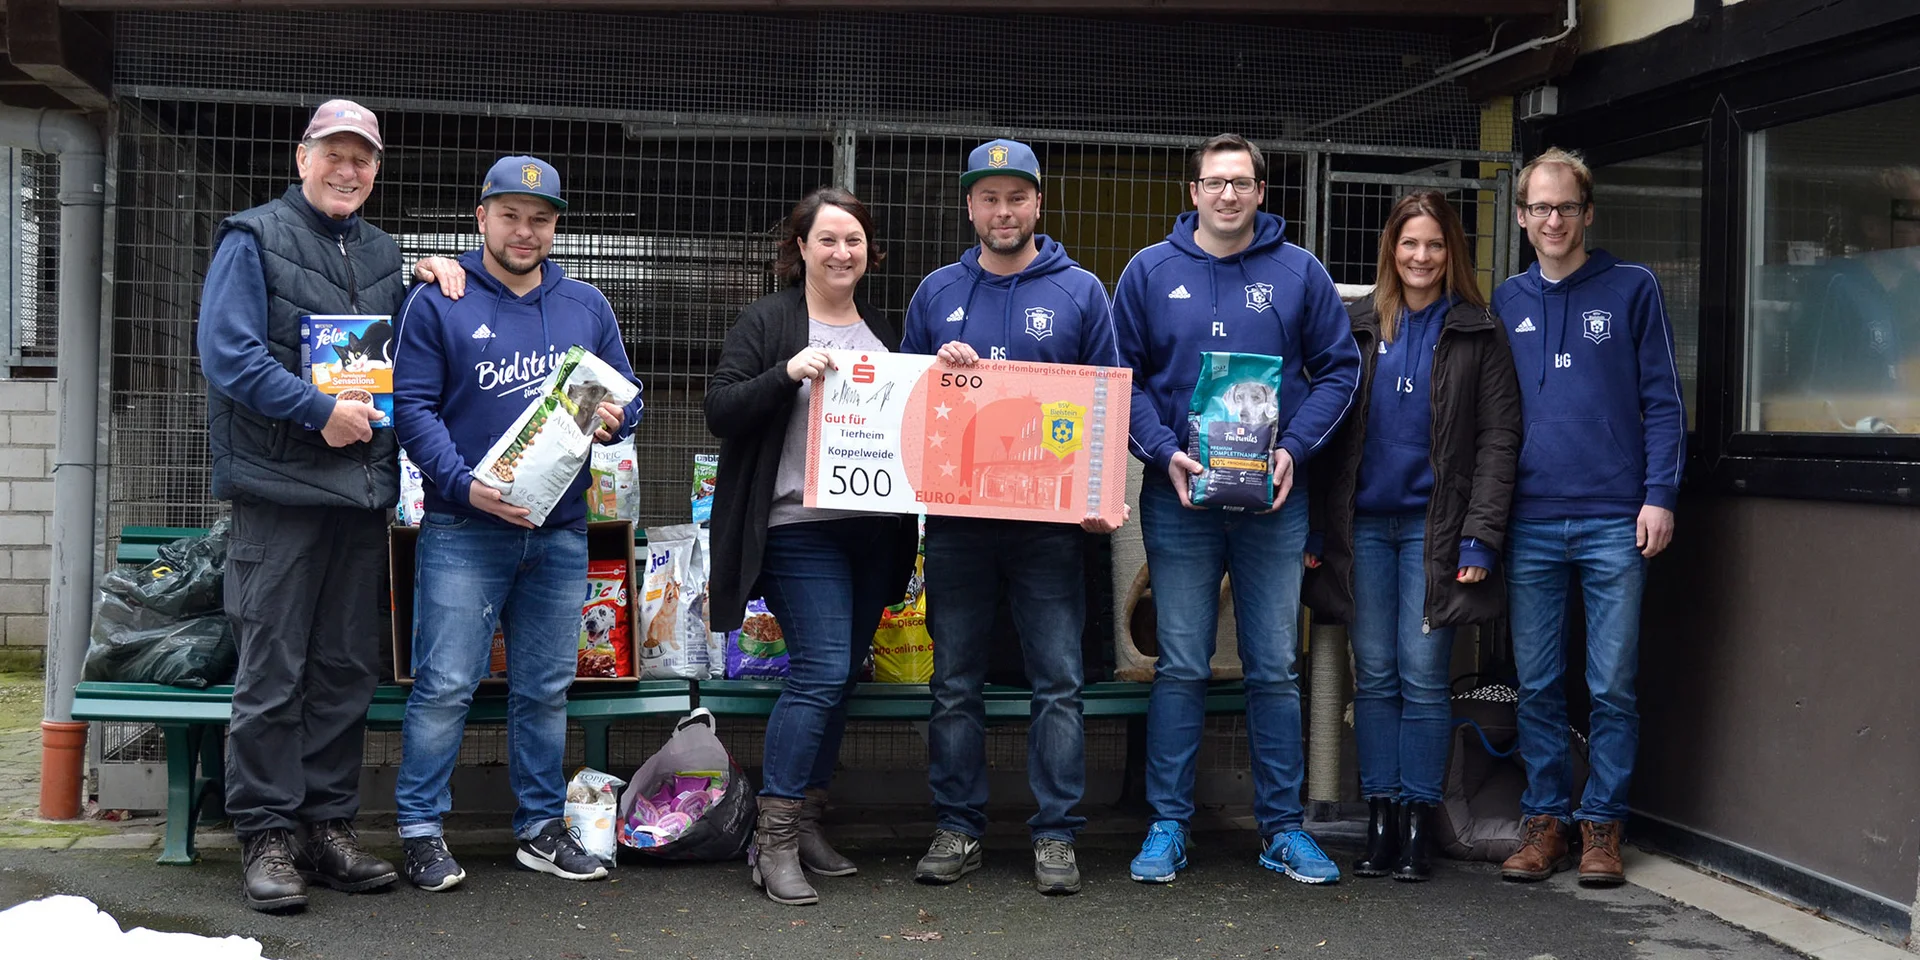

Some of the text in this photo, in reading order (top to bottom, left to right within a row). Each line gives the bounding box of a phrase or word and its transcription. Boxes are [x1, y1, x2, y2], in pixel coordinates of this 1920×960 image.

[1212, 321, 1227, 336] FL
[315, 327, 349, 350] felix
[991, 346, 1006, 360] RS
[1555, 353, 1571, 368] BG
[992, 364, 1006, 372] der
[1008, 365, 1077, 377] Homburgischen
[1079, 368, 1128, 379] Gemeinden
[332, 377, 374, 385] Sensations
[941, 373, 982, 388] 500
[825, 413, 867, 425] Gut für
[840, 429, 884, 440] Tierheim
[594, 451, 621, 460] TOPIC
[828, 446, 894, 460] Koppelweide
[829, 465, 892, 497] 500
[915, 490, 955, 504] EURO
[650, 550, 670, 573] ja!
[585, 582, 613, 601] lic
[580, 773, 610, 784] TOPIC
